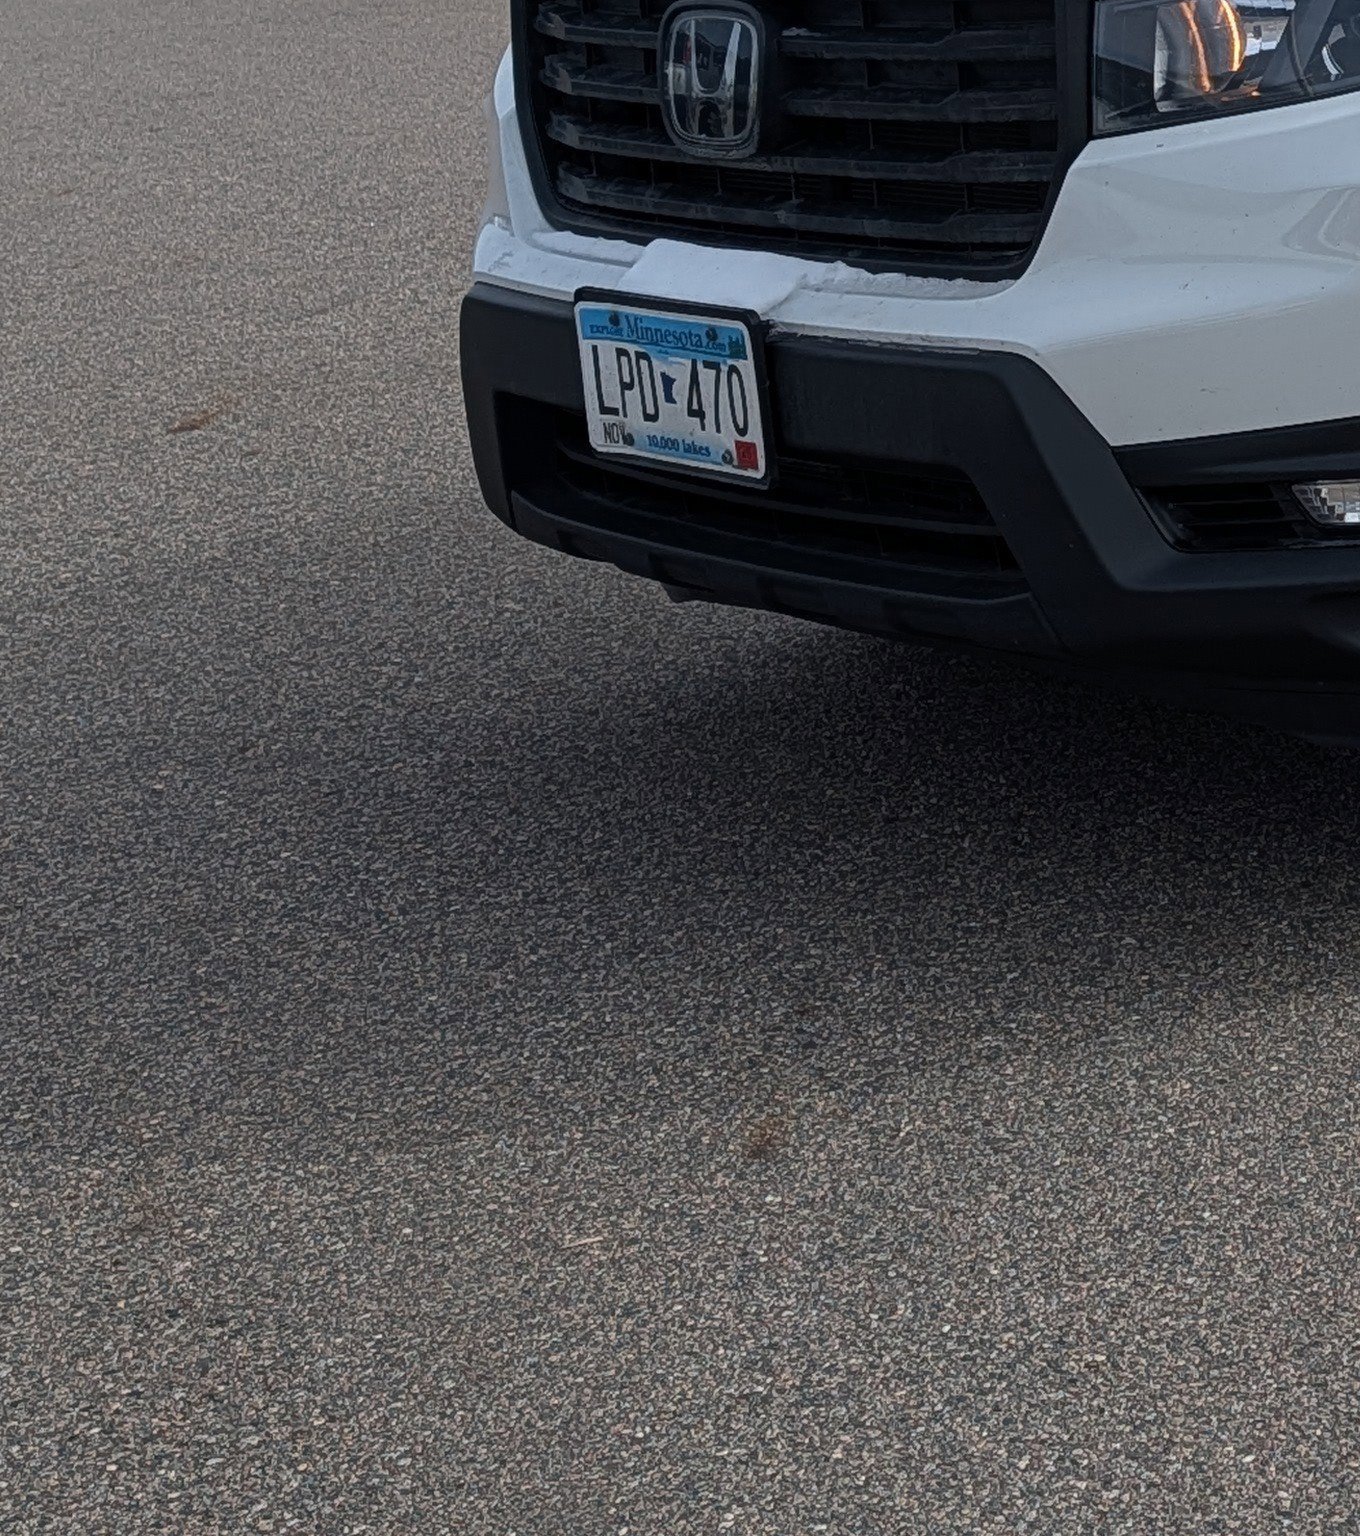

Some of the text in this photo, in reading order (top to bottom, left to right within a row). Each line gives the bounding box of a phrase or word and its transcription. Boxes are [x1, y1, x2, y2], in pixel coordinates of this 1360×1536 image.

[592, 345, 749, 437] LPD 470
[681, 438, 711, 458] lakes
